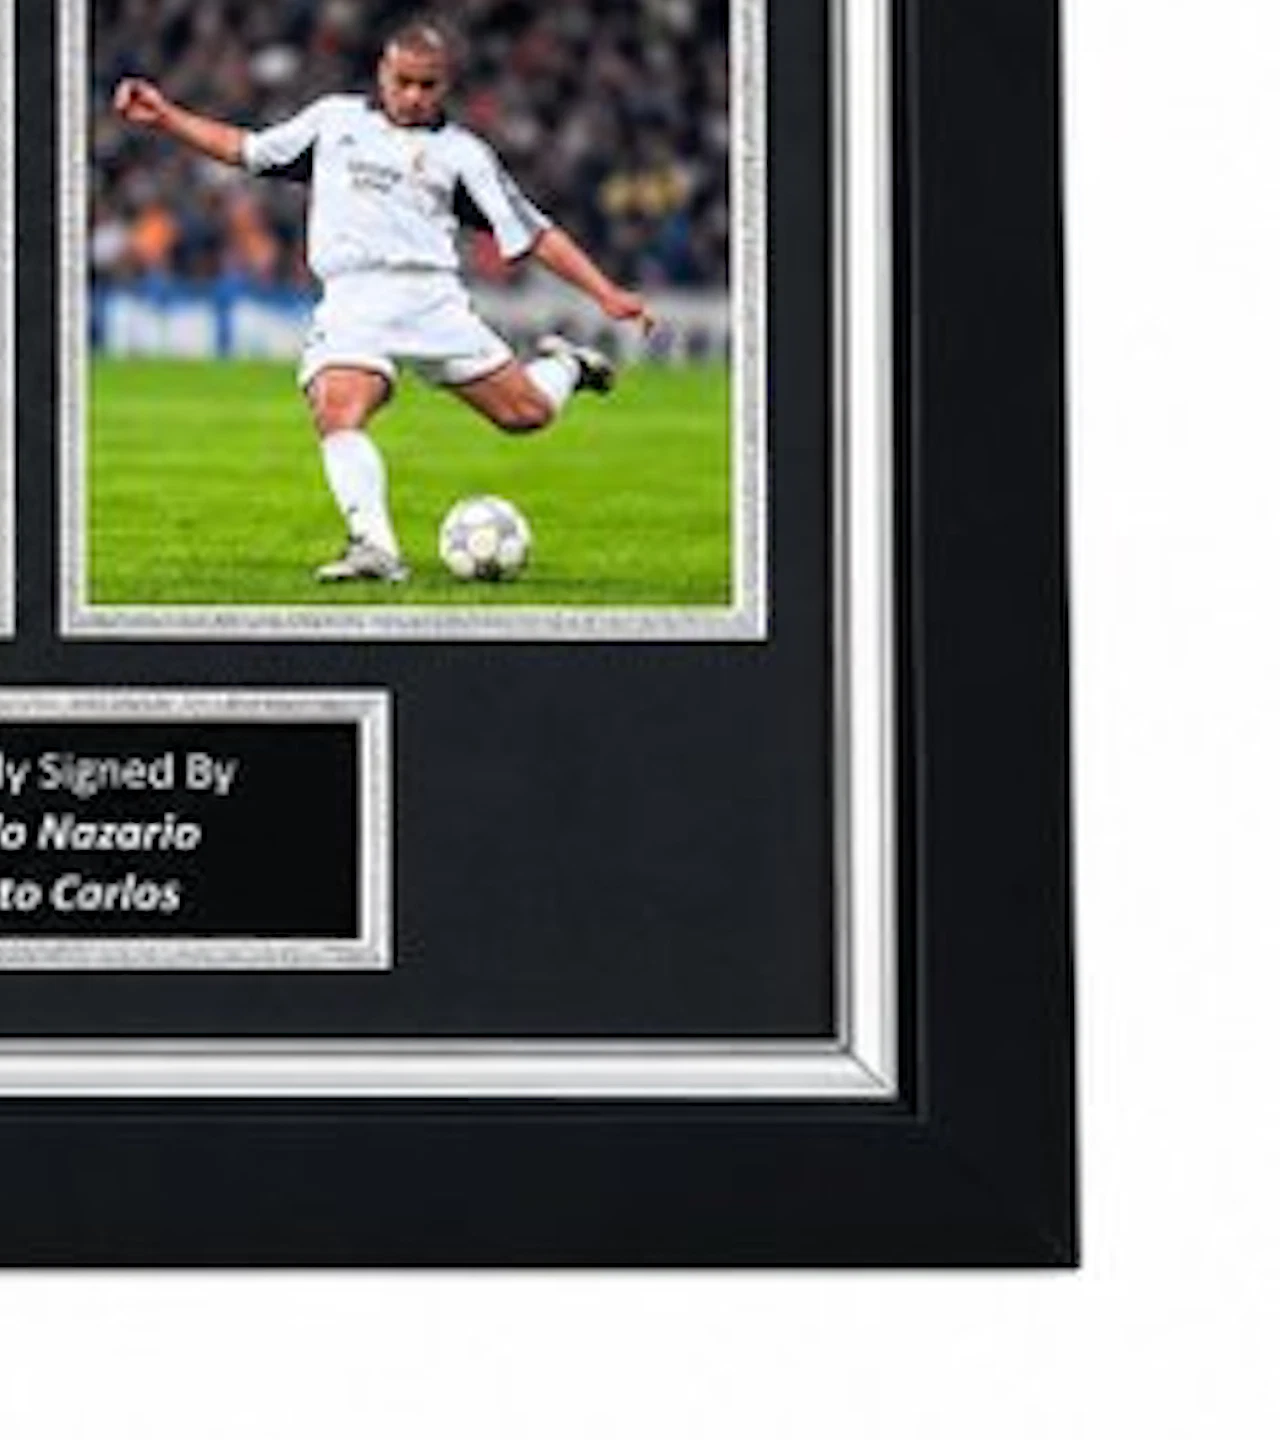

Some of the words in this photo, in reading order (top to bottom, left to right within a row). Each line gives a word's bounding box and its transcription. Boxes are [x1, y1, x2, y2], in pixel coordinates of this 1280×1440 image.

[39, 751, 174, 800] Signed
[185, 751, 239, 796] By
[38, 812, 202, 851] Nazario
[49, 872, 181, 911] Carlos
